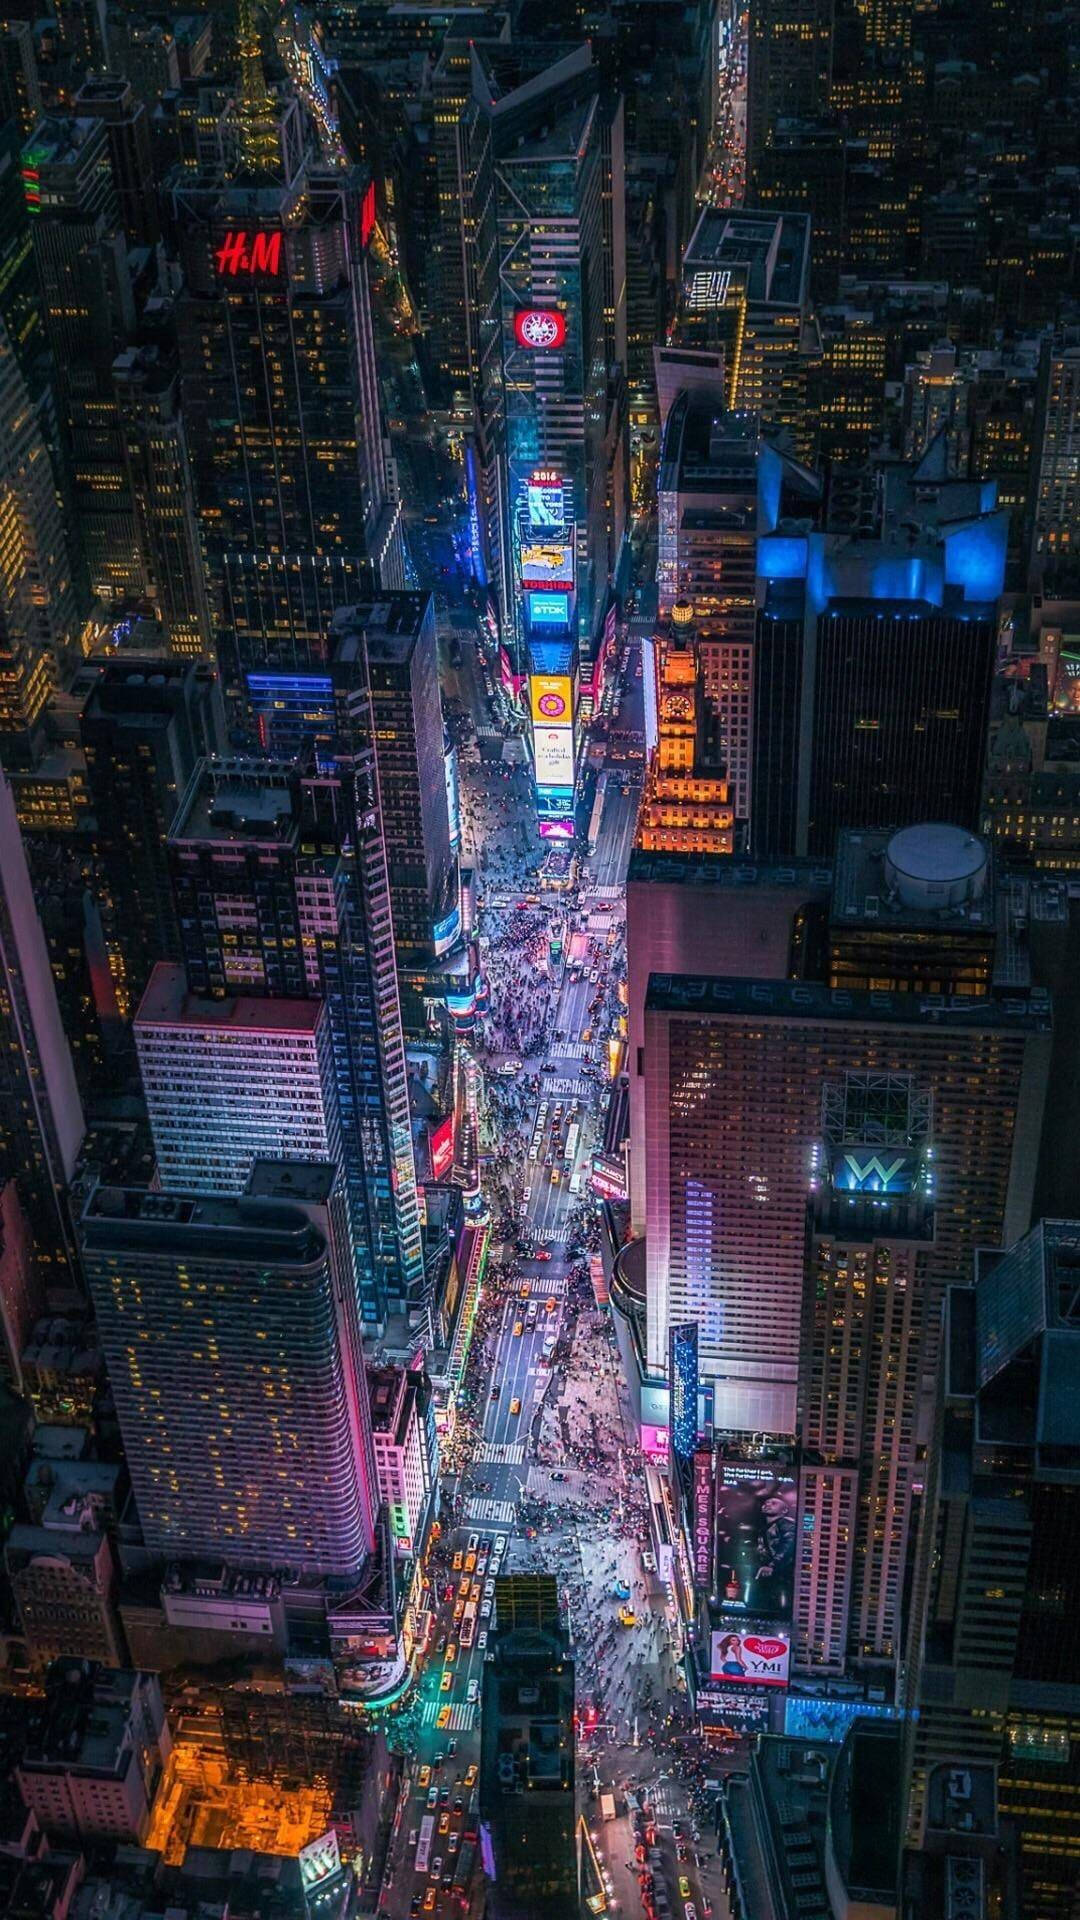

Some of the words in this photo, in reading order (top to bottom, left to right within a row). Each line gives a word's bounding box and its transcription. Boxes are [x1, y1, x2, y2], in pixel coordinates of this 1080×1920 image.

[216, 231, 282, 275] H&M
[533, 471, 556, 480] 2016
[523, 580, 573, 590] TOSHIBA
[843, 1154, 907, 1183] W
[696, 1466, 710, 1513] TIMES
[696, 1518, 710, 1573] SQUARE
[751, 1660, 781, 1672] YMI
